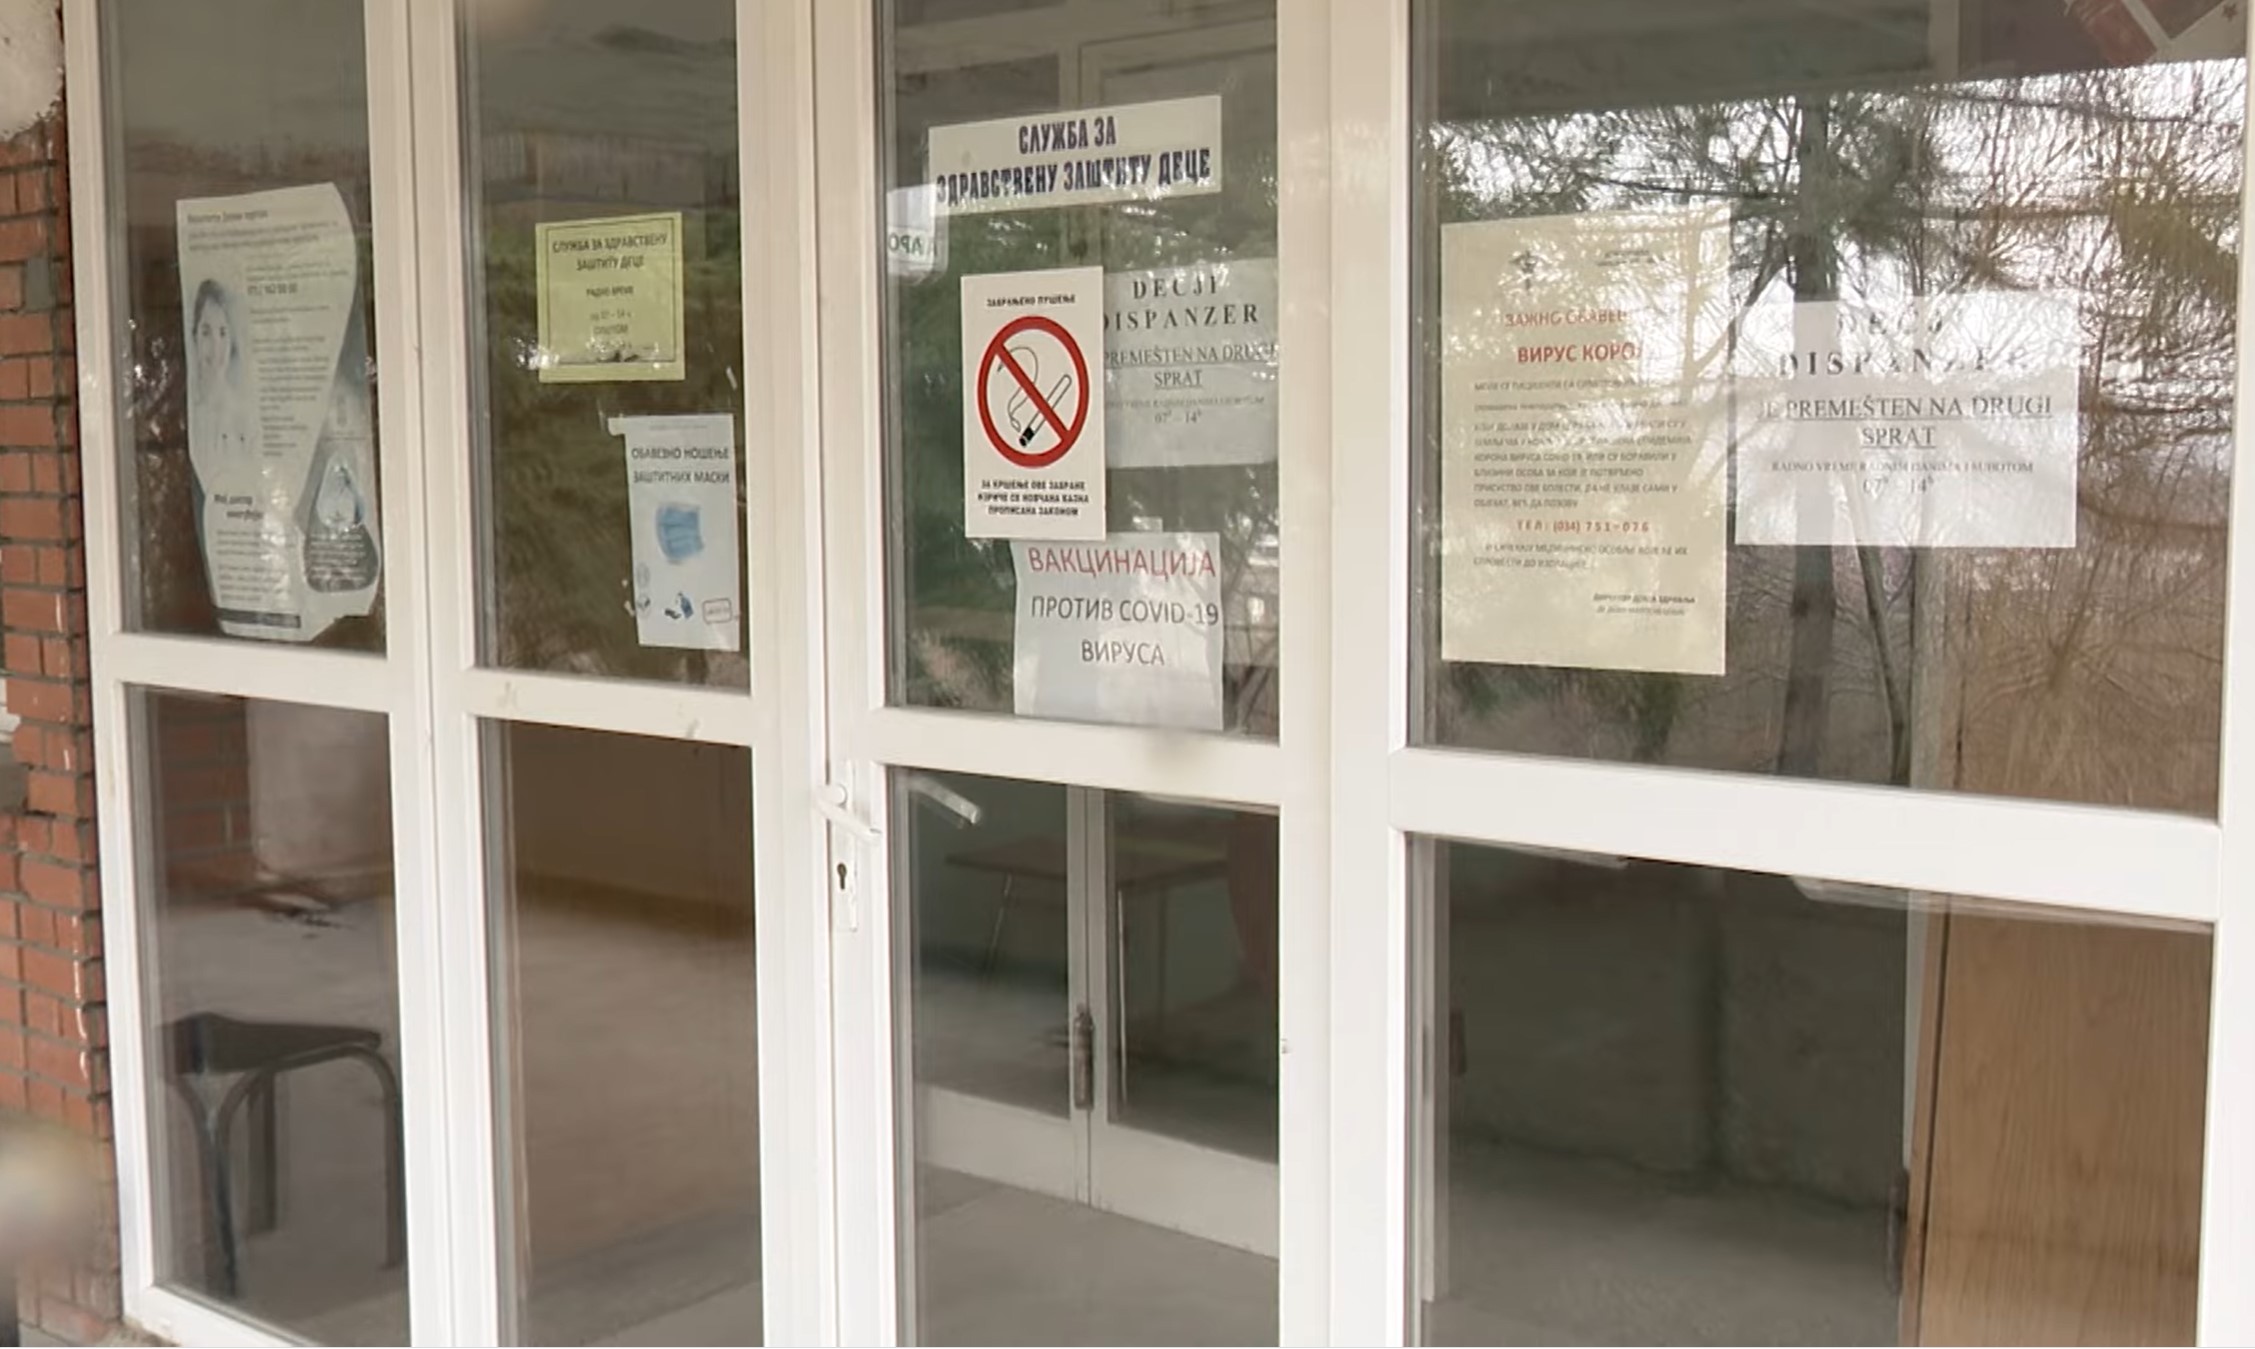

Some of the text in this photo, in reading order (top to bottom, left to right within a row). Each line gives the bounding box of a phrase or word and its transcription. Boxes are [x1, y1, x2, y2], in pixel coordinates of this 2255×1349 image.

[1018, 114, 1117, 155] СЛУЖБА ЗА
[935, 147, 1211, 207] ЗДРАВСТВЕНУ ЗАШТИТУ ДЕЦЕ
[986, 293, 1076, 308] ЗАБРАЊЕНО ПУШЕЊЕ
[1196, 346, 1220, 363] NA
[1517, 345, 1578, 363] ВИРУС
[1154, 369, 1204, 390] SPRAT
[1785, 394, 1923, 419] PREMEŠTEN
[1928, 397, 1964, 419] NA
[1971, 395, 2053, 419] DRUGI
[1860, 426, 1937, 449] SPRAT
[631, 446, 682, 460] ОБАВЕЗНО
[693, 469, 730, 484] МАСКИ
[993, 479, 1029, 490] КРШЕЊЕ
[1048, 480, 1086, 491] ЗАБРАНЕ
[1022, 494, 1060, 503] НОВЧАНА
[1061, 494, 1090, 503] КАЗНА
[987, 505, 1080, 516] ПРОПИСАНА ЗАКОНОМ
[1027, 546, 1217, 582] ВАКЦИНАЦИЈА
[1030, 595, 1220, 627] ПРОТИВ COVID-19
[1080, 638, 1166, 667] ВИРУСА
